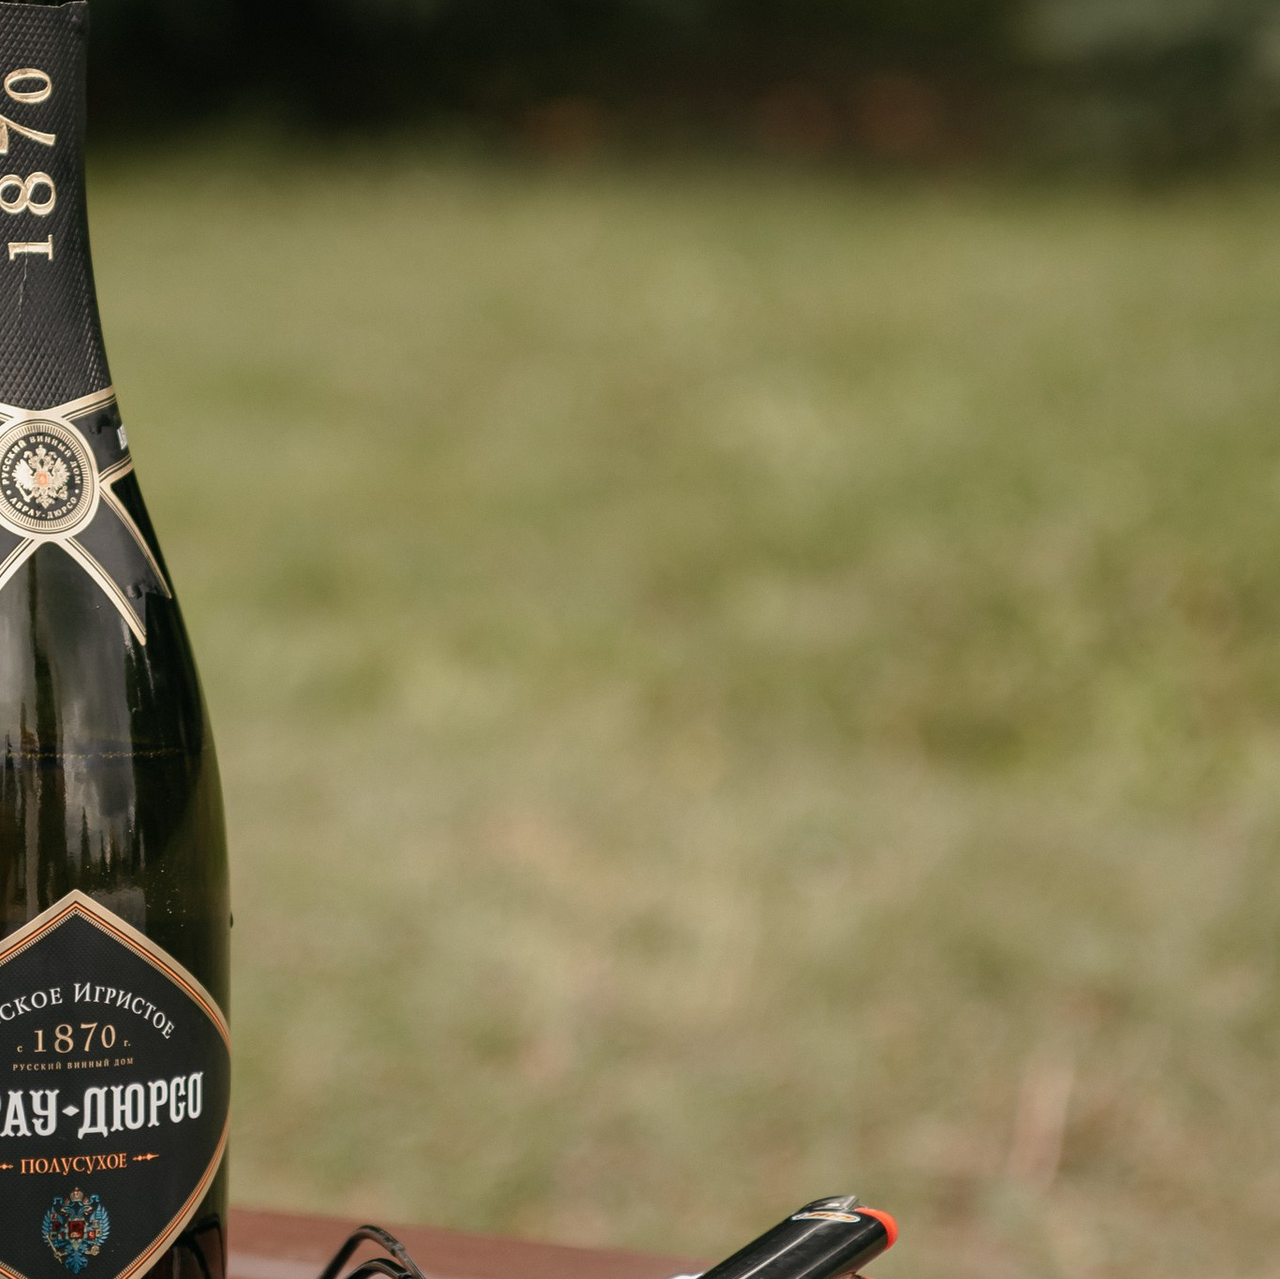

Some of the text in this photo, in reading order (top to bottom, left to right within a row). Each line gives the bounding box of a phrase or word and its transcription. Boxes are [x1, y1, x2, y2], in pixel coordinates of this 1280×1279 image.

[74, 982, 175, 1039] ИГРИСТОЕ
[34, 1022, 116, 1054] 1870
[12, 1057, 134, 1072] РУССКИЙ ВИННЫЙ ДОМ
[20, 1153, 127, 1176] ПОЛУСУХОЕ
